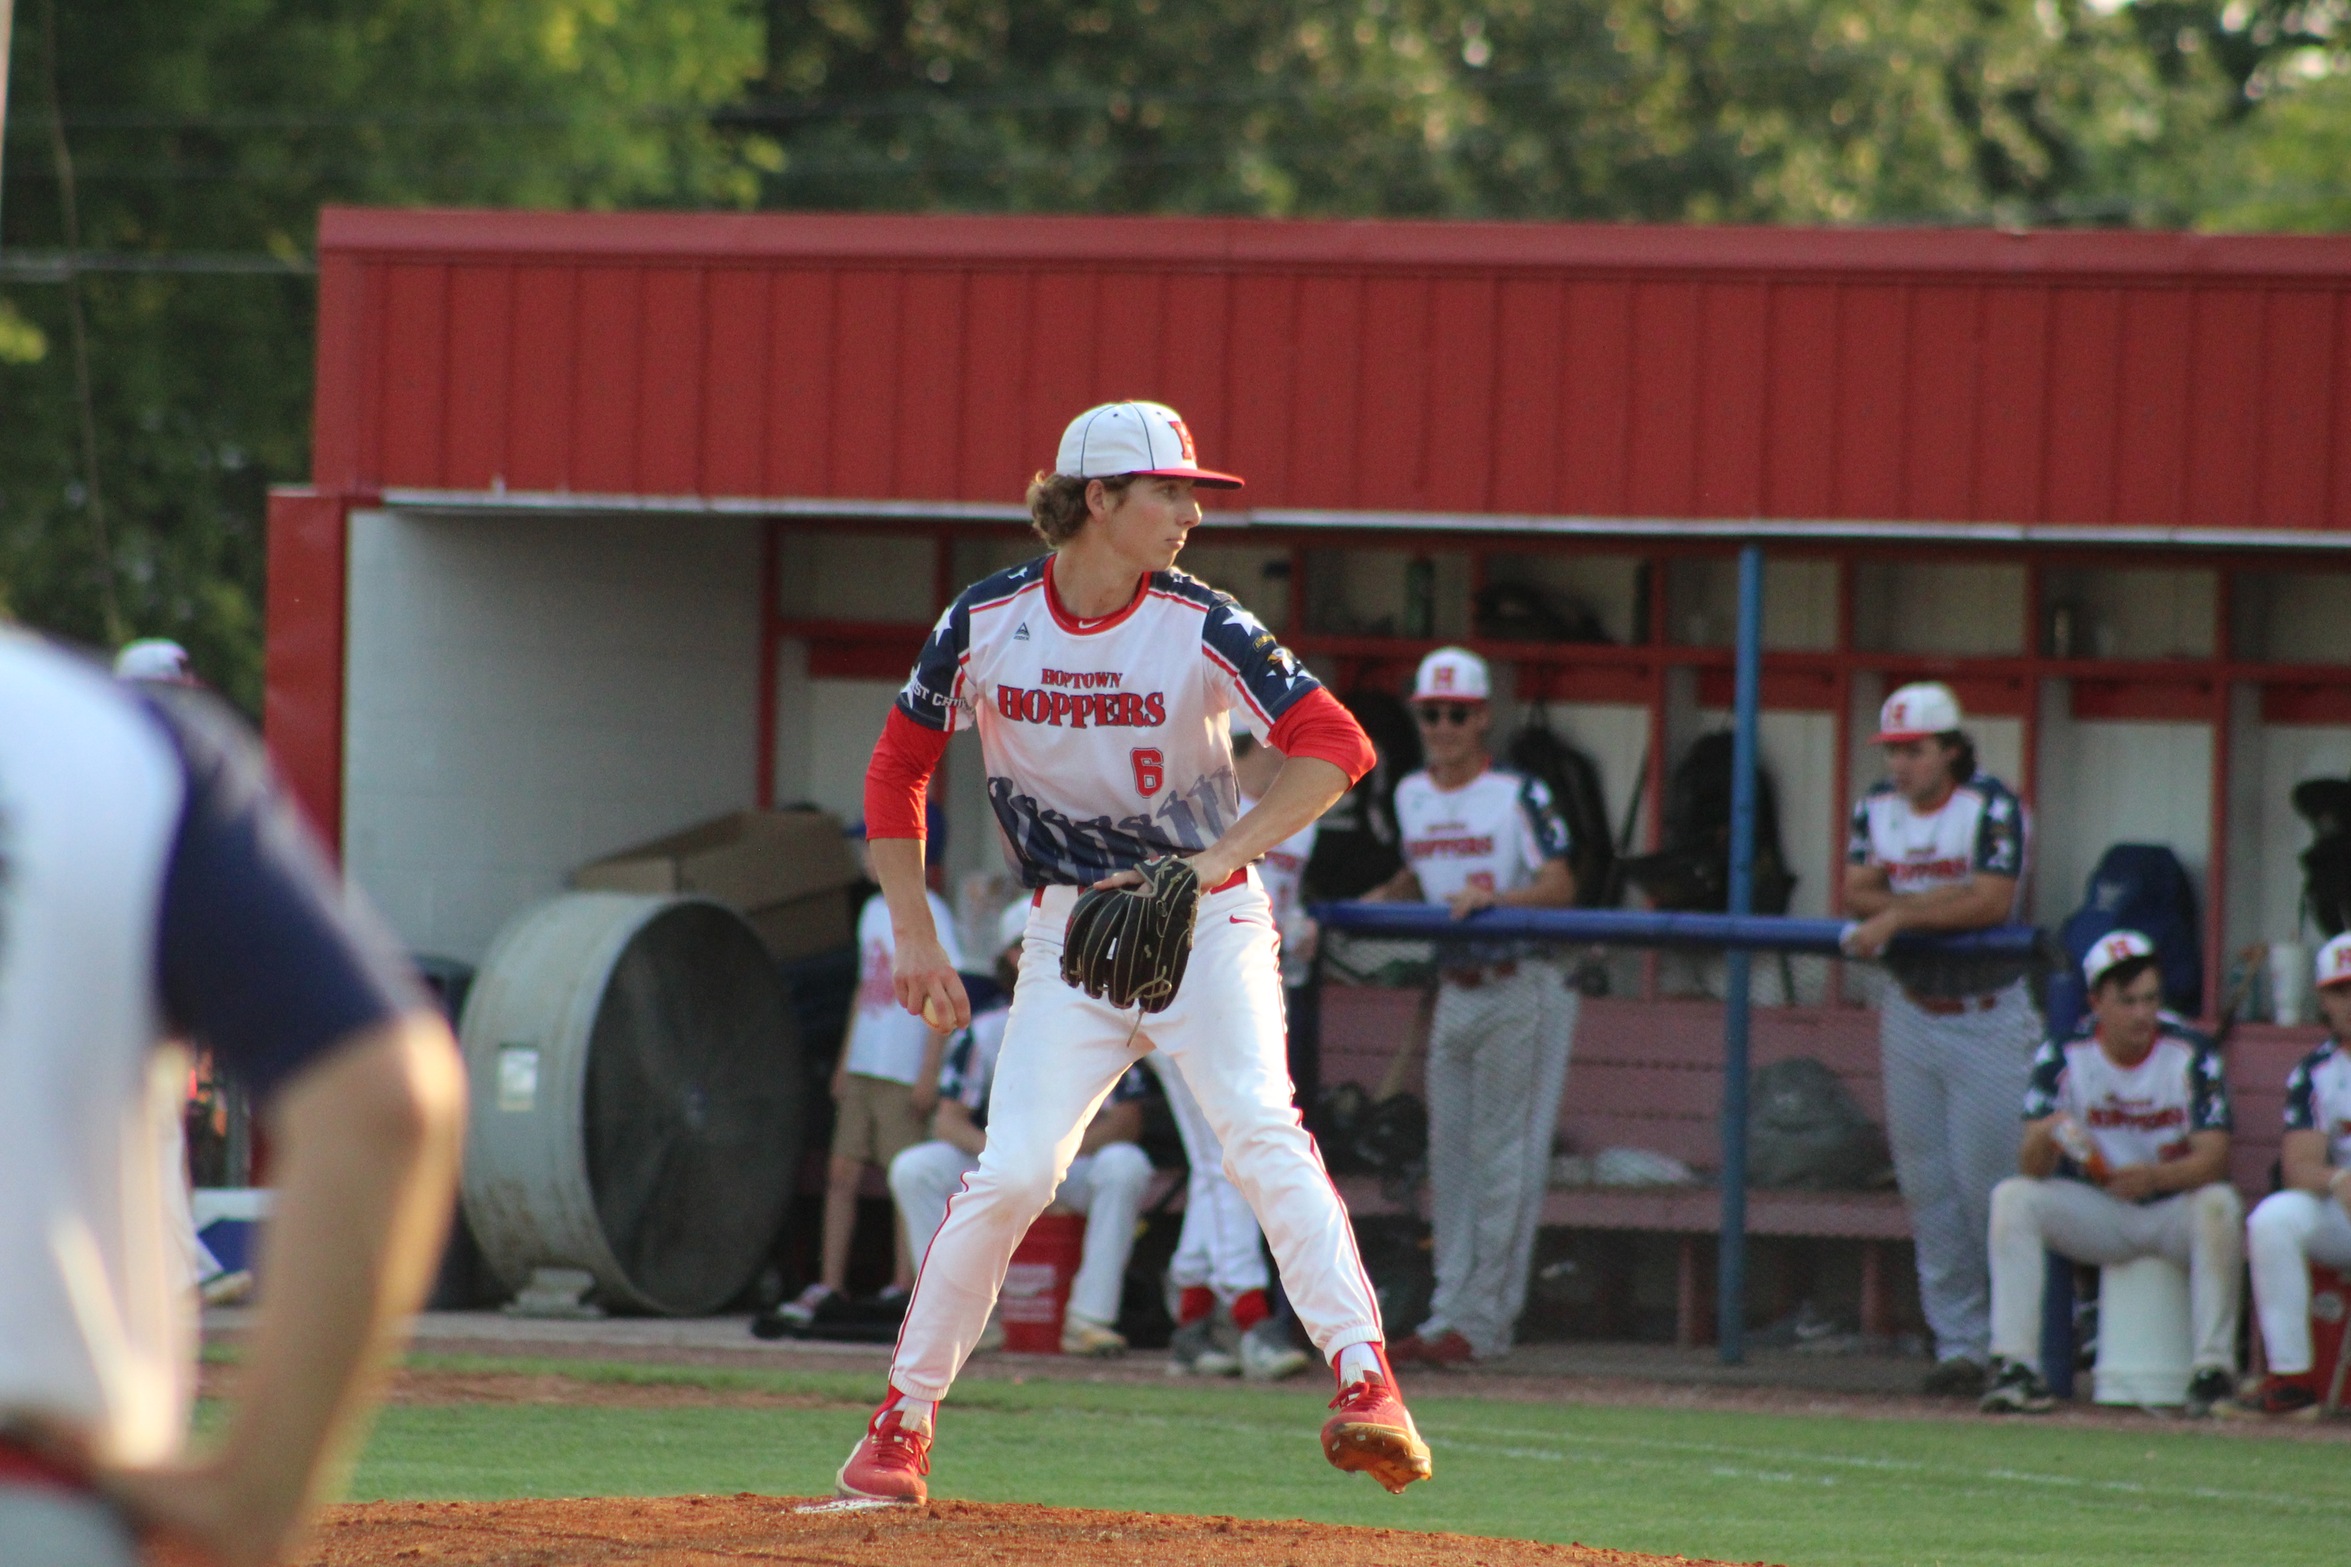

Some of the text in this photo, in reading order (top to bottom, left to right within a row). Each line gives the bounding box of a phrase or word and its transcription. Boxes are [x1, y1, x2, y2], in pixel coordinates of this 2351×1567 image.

[1041, 668, 1123, 688] HOPTOWN
[997, 684, 1166, 729] HOPPERS
[1130, 747, 1165, 798] 6
